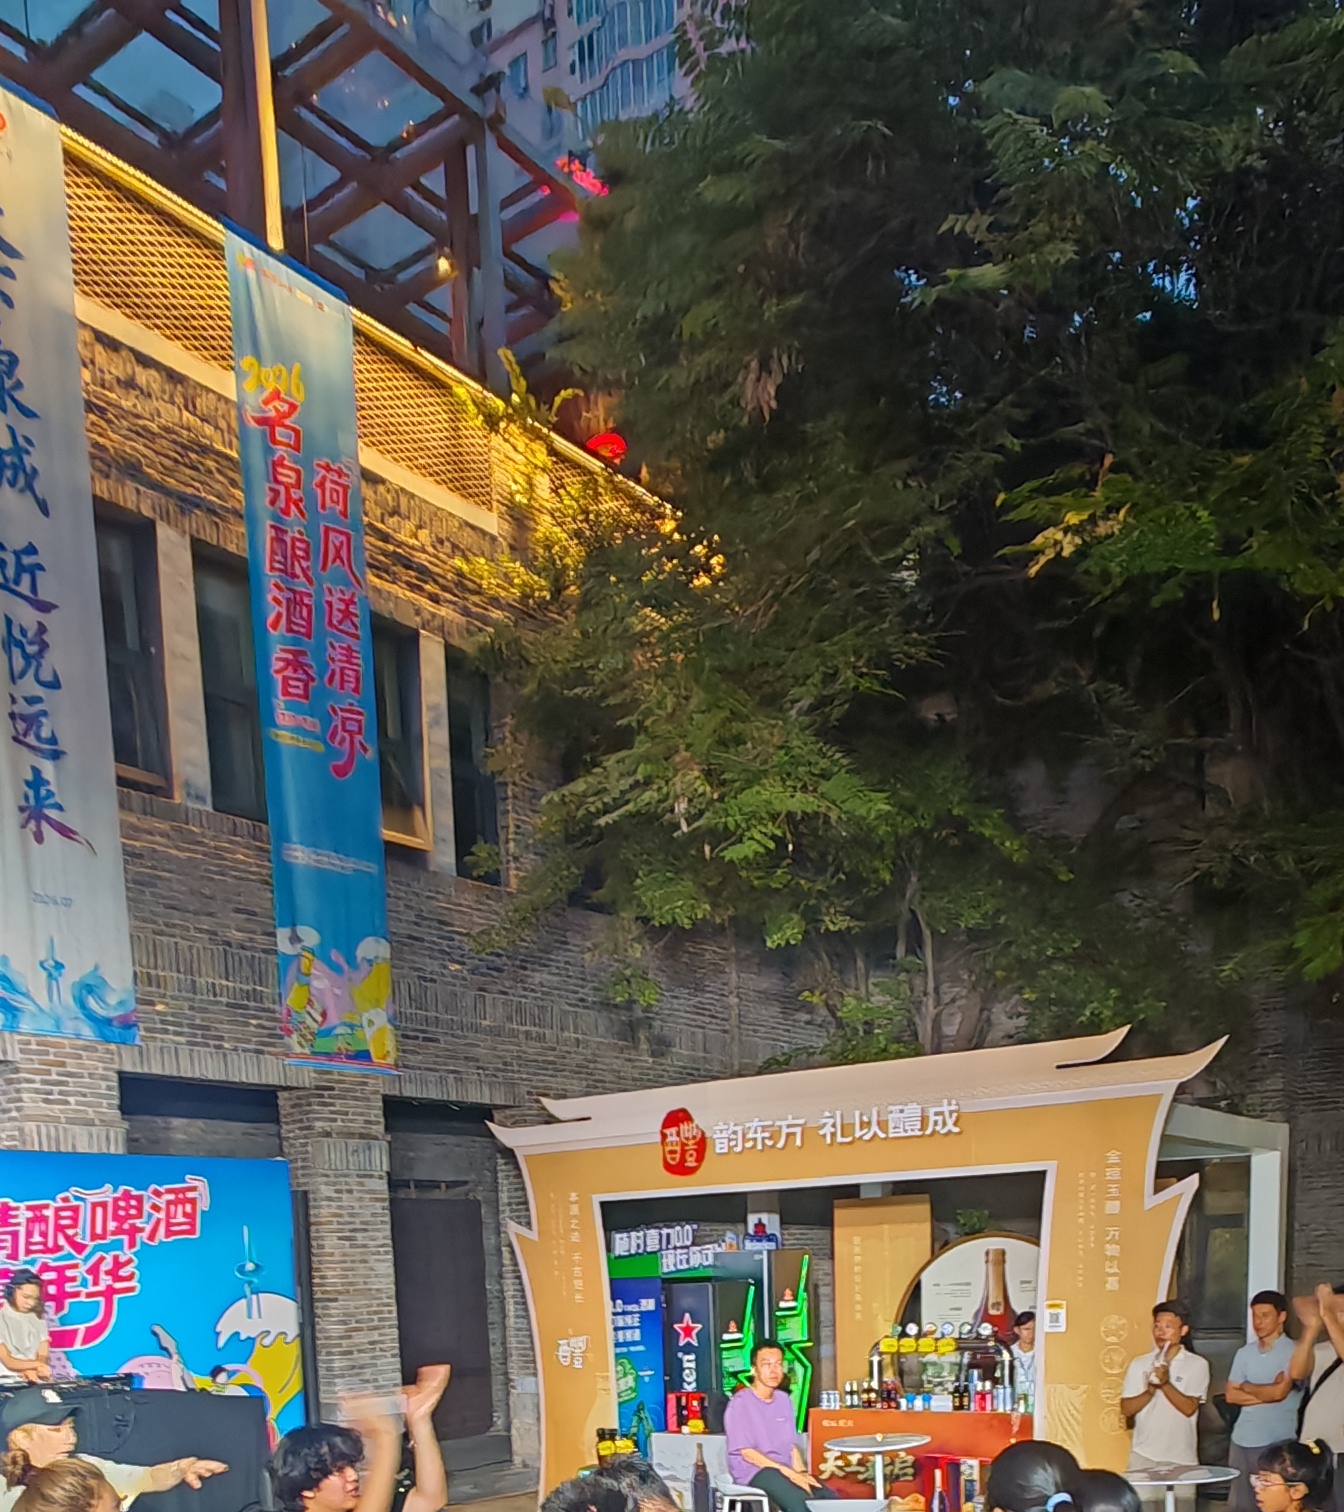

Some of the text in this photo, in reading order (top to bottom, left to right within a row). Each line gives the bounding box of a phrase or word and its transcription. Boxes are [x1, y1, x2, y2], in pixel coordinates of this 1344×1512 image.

[242, 385, 317, 703] 名泉酿酒香
[312, 456, 373, 780] 荷风送清凉
[712, 1115, 806, 1154] 韵东方
